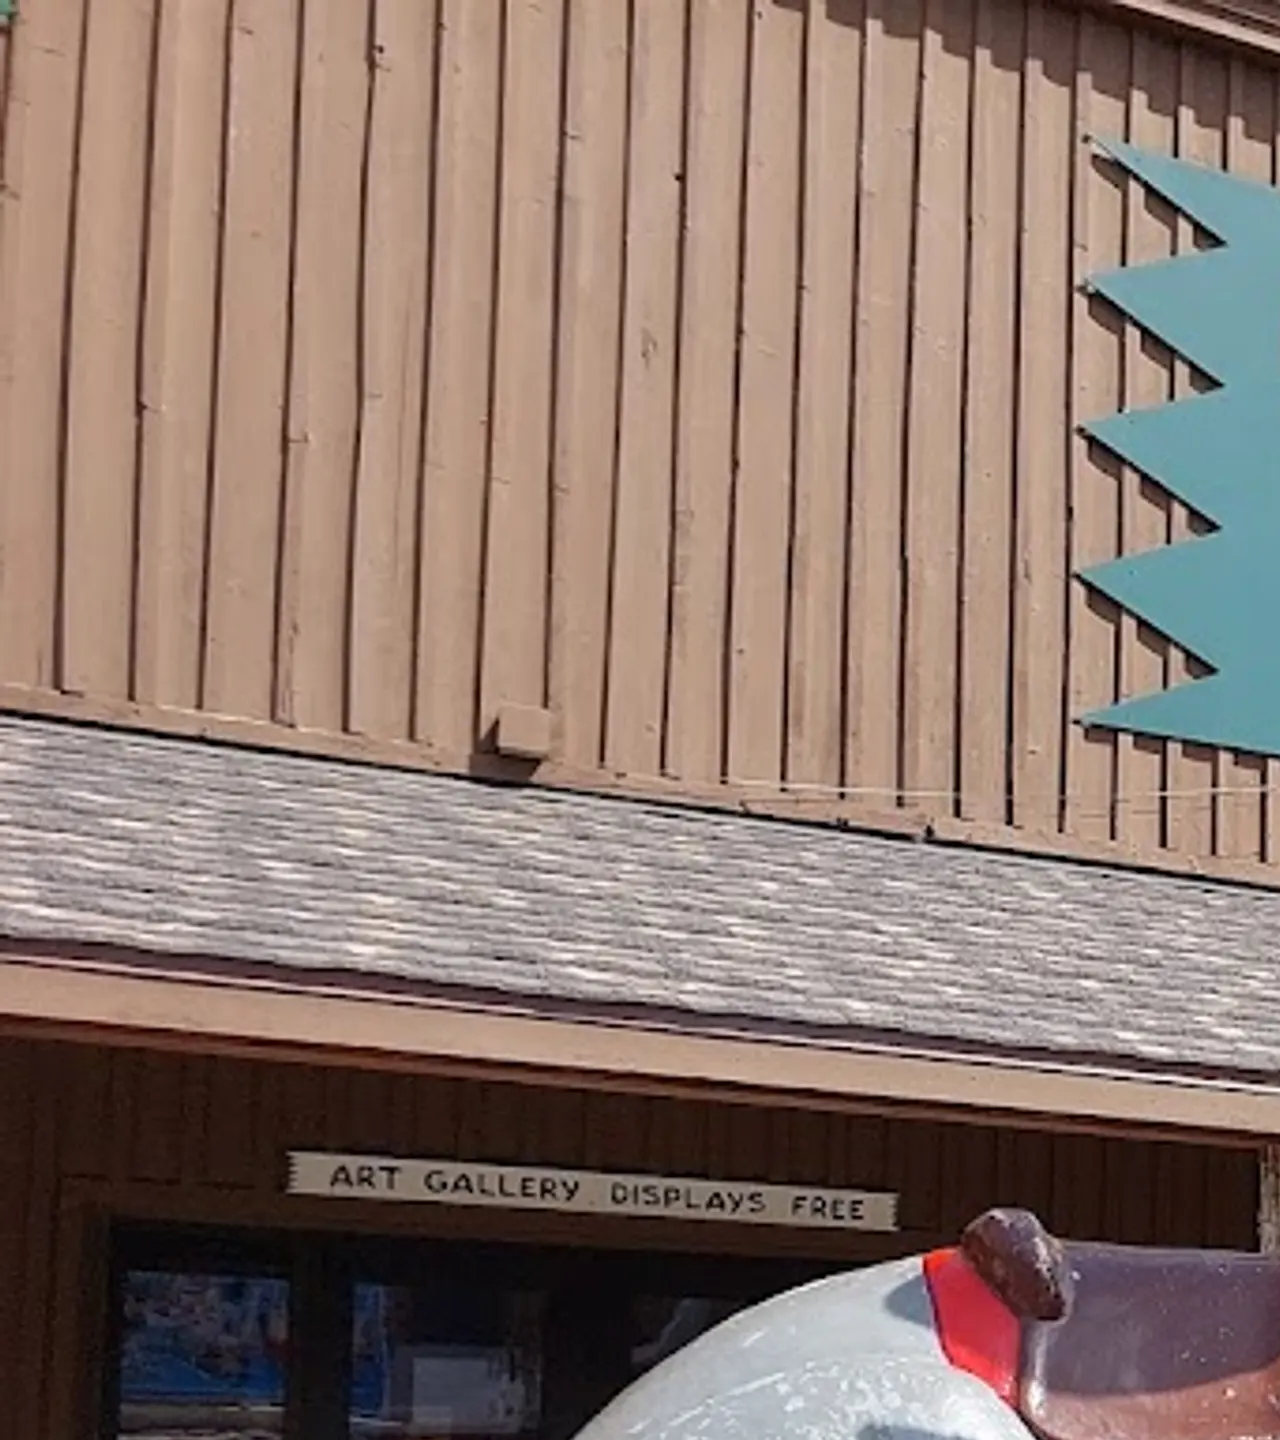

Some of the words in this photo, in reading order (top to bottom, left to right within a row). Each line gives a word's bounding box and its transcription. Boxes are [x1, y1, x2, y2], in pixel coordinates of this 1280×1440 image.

[330, 1165, 400, 1189] ART
[424, 1169, 579, 1202] GALLERY
[611, 1183, 767, 1213] DISPLAYS
[792, 1195, 865, 1221] FREE
